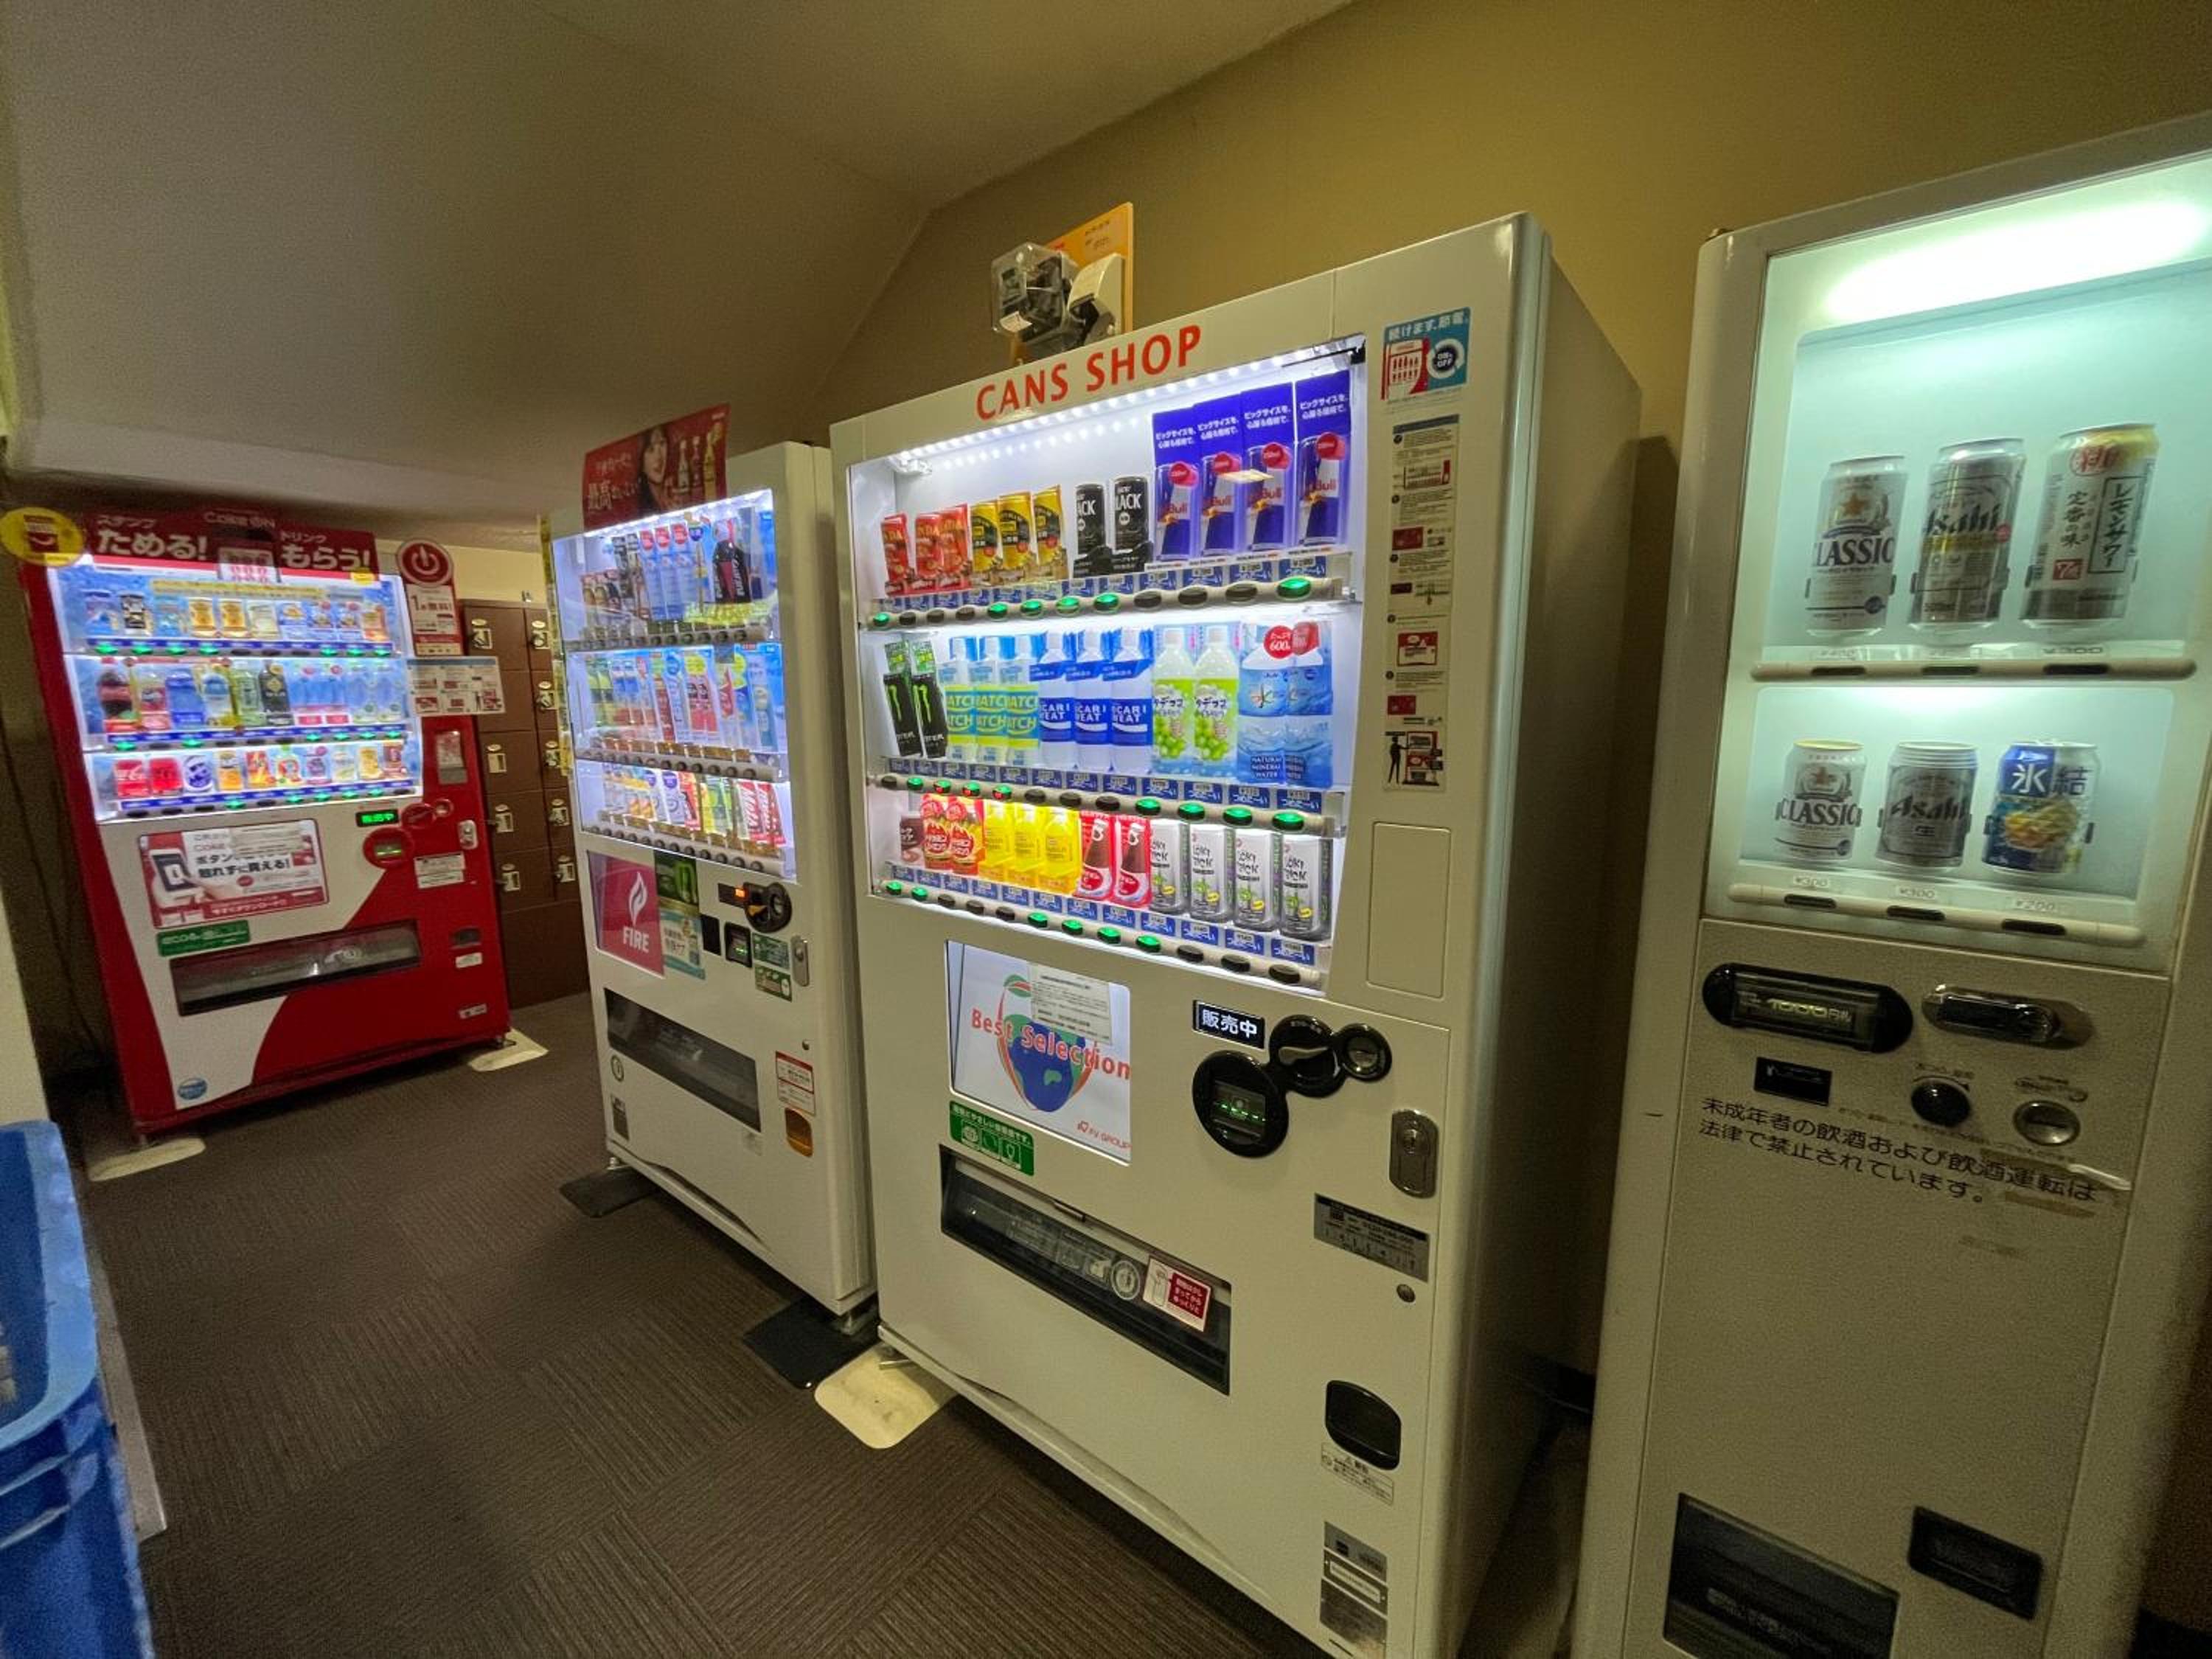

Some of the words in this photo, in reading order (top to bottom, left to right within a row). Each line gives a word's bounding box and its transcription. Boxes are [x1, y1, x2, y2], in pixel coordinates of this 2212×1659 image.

[975, 362, 1068, 421] CANS
[1085, 324, 1203, 392] SHOP
[2102, 482, 2138, 568] レモンサワー
[96, 528, 209, 562] ためる!
[282, 543, 371, 571] もらう!
[1813, 537, 1896, 567] LASSIC
[2011, 762, 2093, 796] 氷結
[1780, 798, 1860, 827] CLASSIC
[1891, 796, 1966, 821] Asahi
[622, 926, 650, 953] FIRE
[1202, 1008, 1257, 1038] 販売中
[971, 1008, 1012, 1040] Best
[1020, 1025, 1131, 1079] Selection
[1698, 1119, 1983, 1204] 法律で禁止されています。
[1702, 1097, 2096, 1203] 未成年者の飲酒および飲酒運転は
